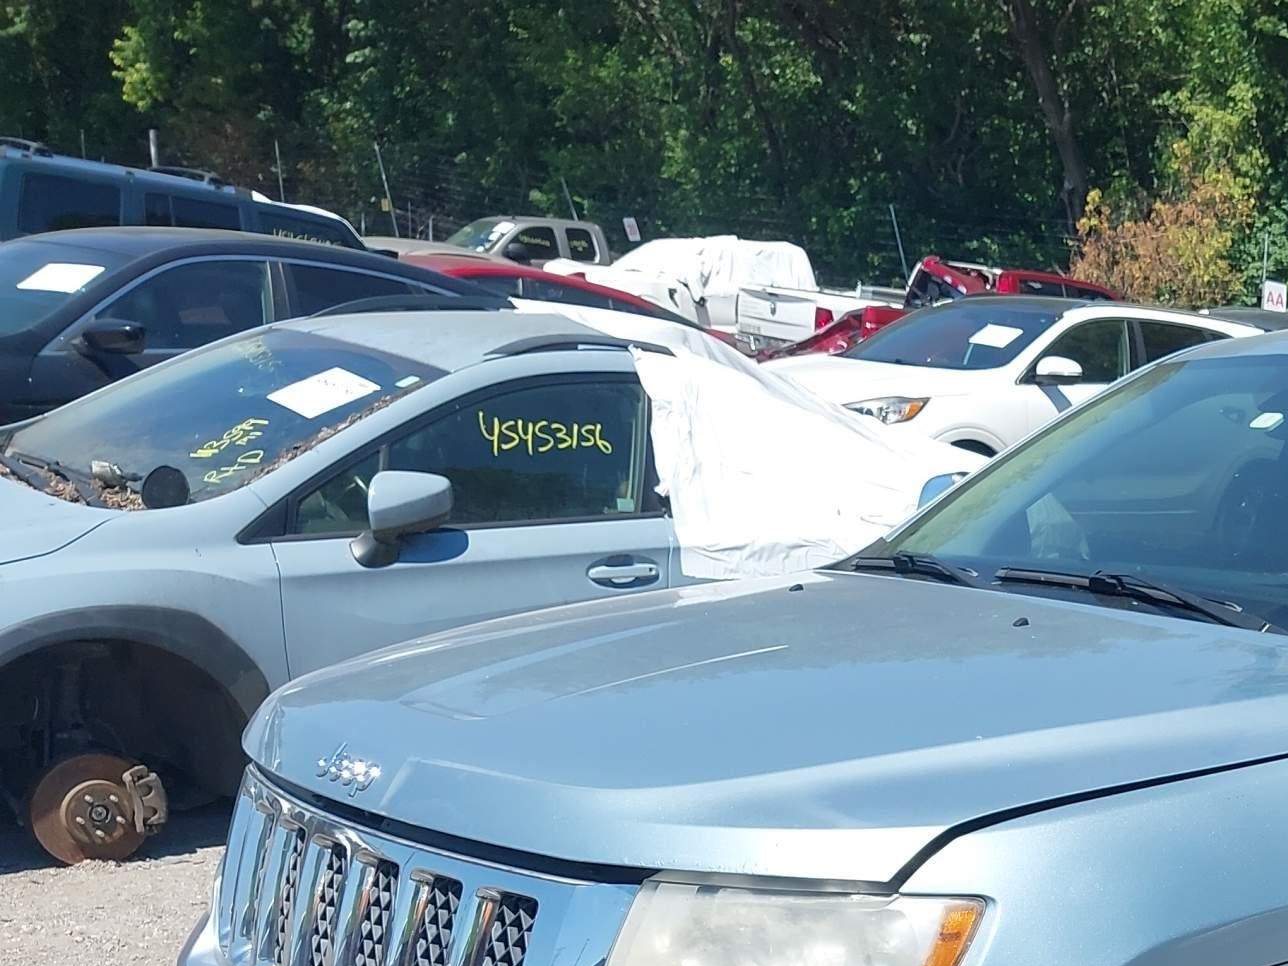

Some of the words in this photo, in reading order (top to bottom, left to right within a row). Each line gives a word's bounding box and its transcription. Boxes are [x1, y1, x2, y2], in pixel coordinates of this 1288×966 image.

[1266, 291, 1284, 308] AA
[478, 411, 613, 456] 45453156
[315, 742, 381, 798] Jeep
